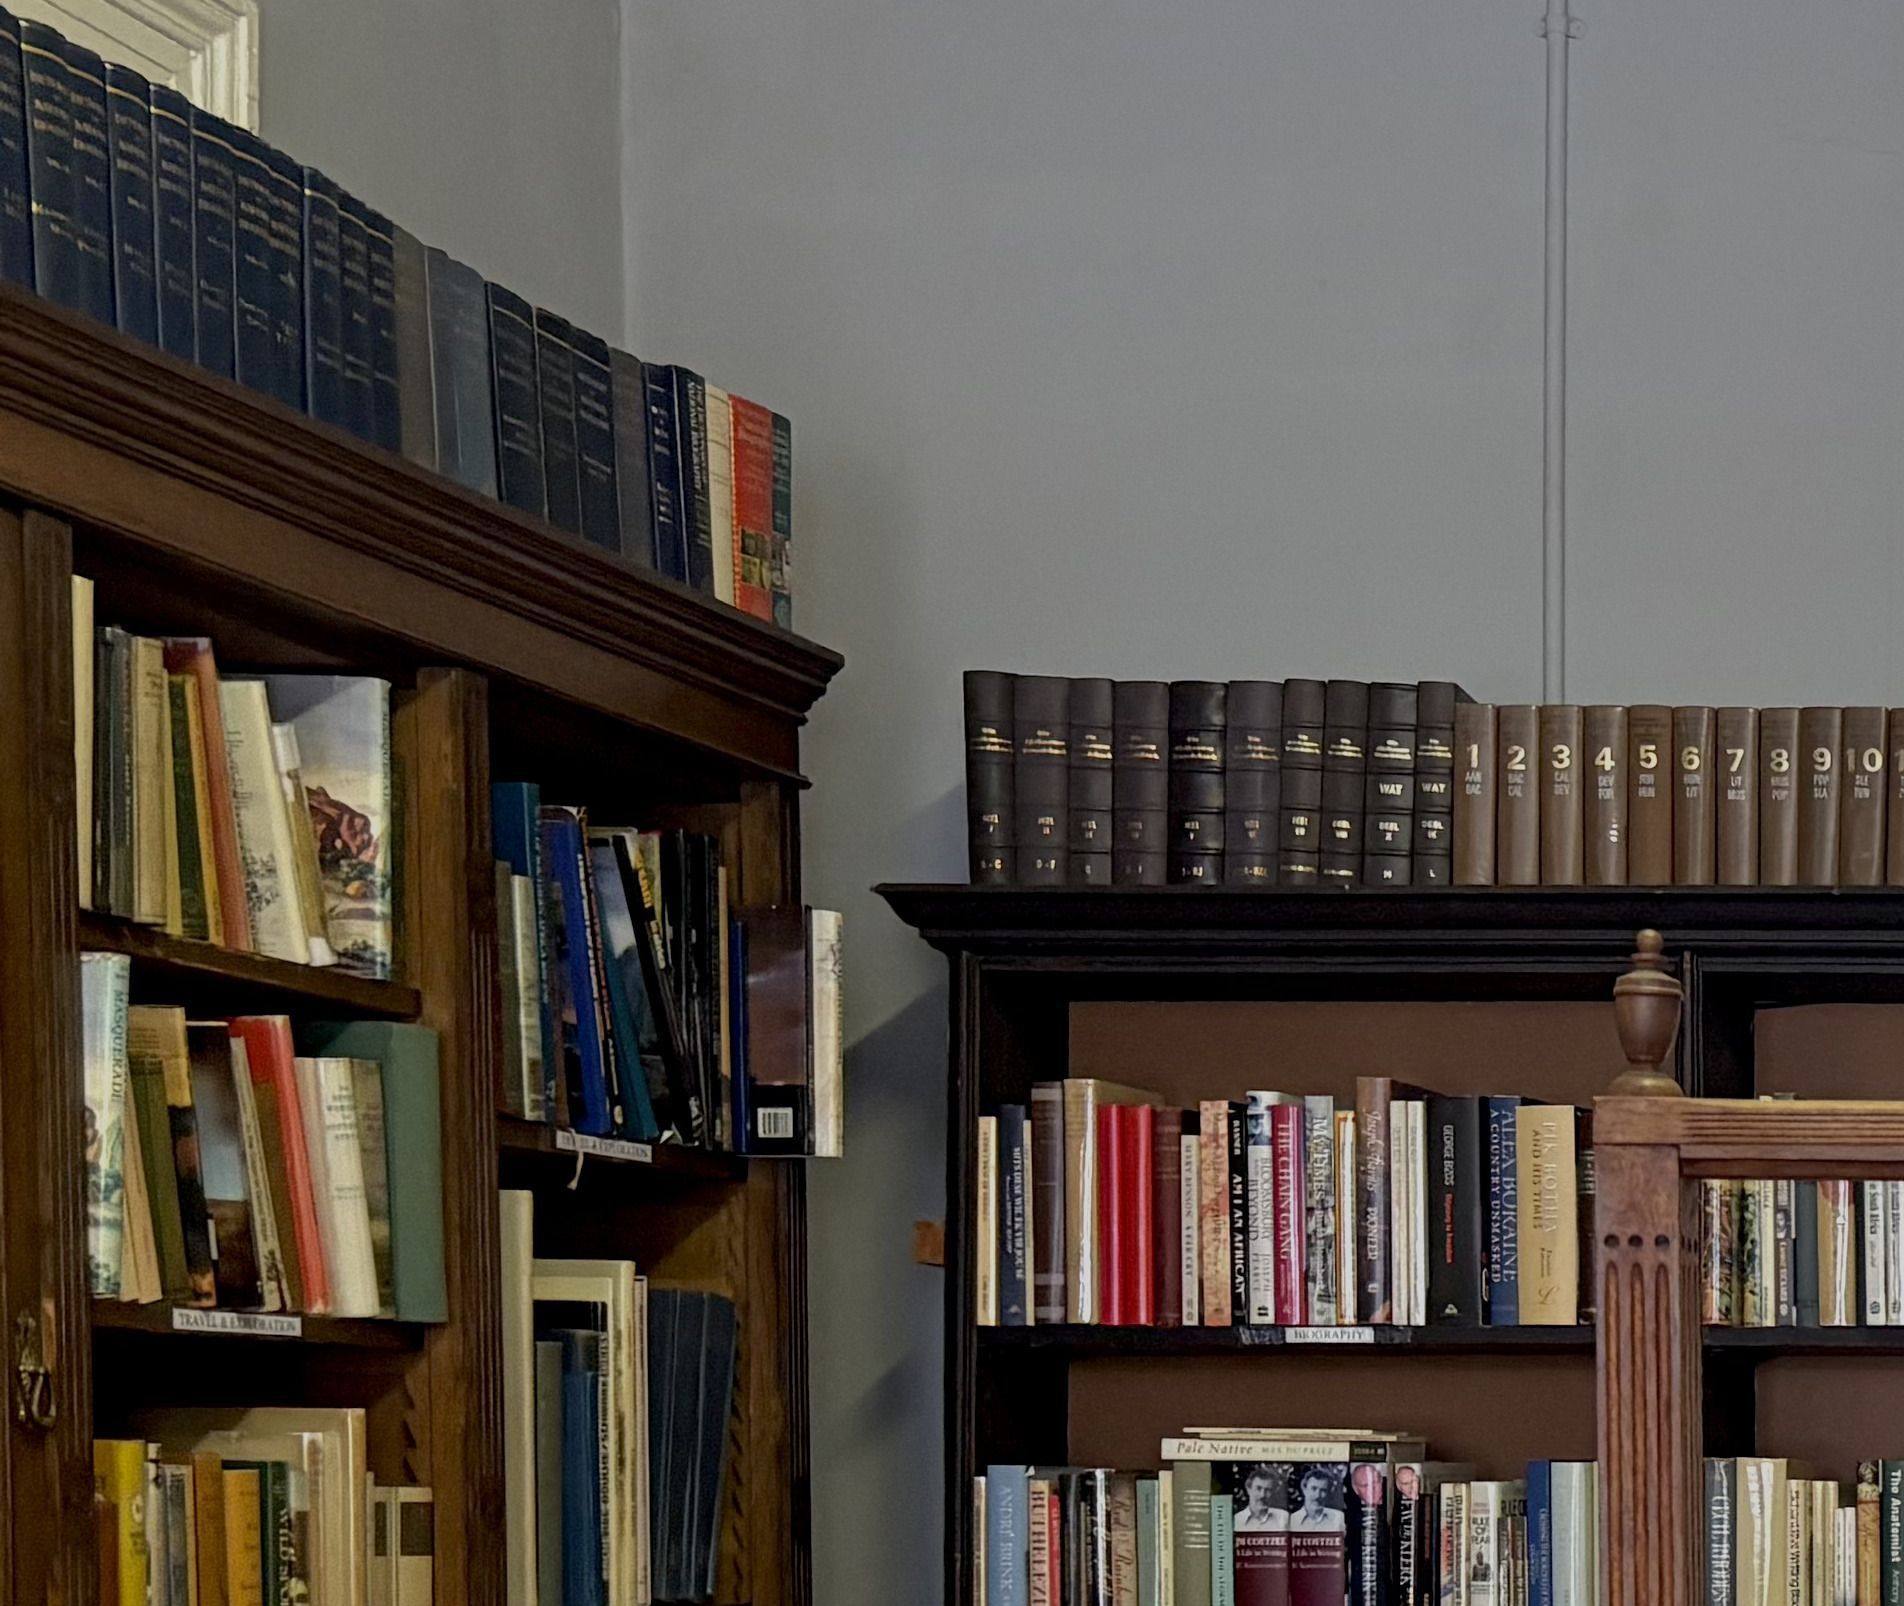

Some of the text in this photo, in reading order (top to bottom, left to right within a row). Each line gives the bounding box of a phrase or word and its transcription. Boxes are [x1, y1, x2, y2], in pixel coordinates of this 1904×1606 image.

[1466, 744, 1479, 769] 1
[1507, 745, 1527, 770] 2
[1552, 745, 1571, 769] 3
[1594, 746, 1616, 771] 4
[1639, 745, 1658, 769] 5
[1681, 746, 1700, 771] 6
[1726, 748, 1745, 772] 7
[1770, 748, 1790, 772] 8
[1812, 747, 1832, 772] 9
[1847, 747, 1883, 772] 10
[1489, 1123, 1500, 1193] COUNTRY
[1232, 1174, 1243, 1194] AM
[1278, 1122, 1291, 1260] THE CHAIN GANG
[1530, 1129, 1541, 1231] AND HIS TIMES
[1501, 1110, 1516, 1282] ALEX BORAINE
[1233, 1209, 1243, 1227] AN
[1248, 1179, 1259, 1241] BEYOND
[1490, 1200, 1501, 1283] UNMASKED
[1233, 1232, 1244, 1293] AFRICAN
[1294, 1328, 1364, 1341] BIOGRAPHY
[1177, 1442, 1253, 1455] Pale Native
[1889, 1470, 1901, 1562] The Anatomist
[1029, 1489, 1046, 1604] BUTHELEZI
[999, 1541, 1012, 1588] BRINK
